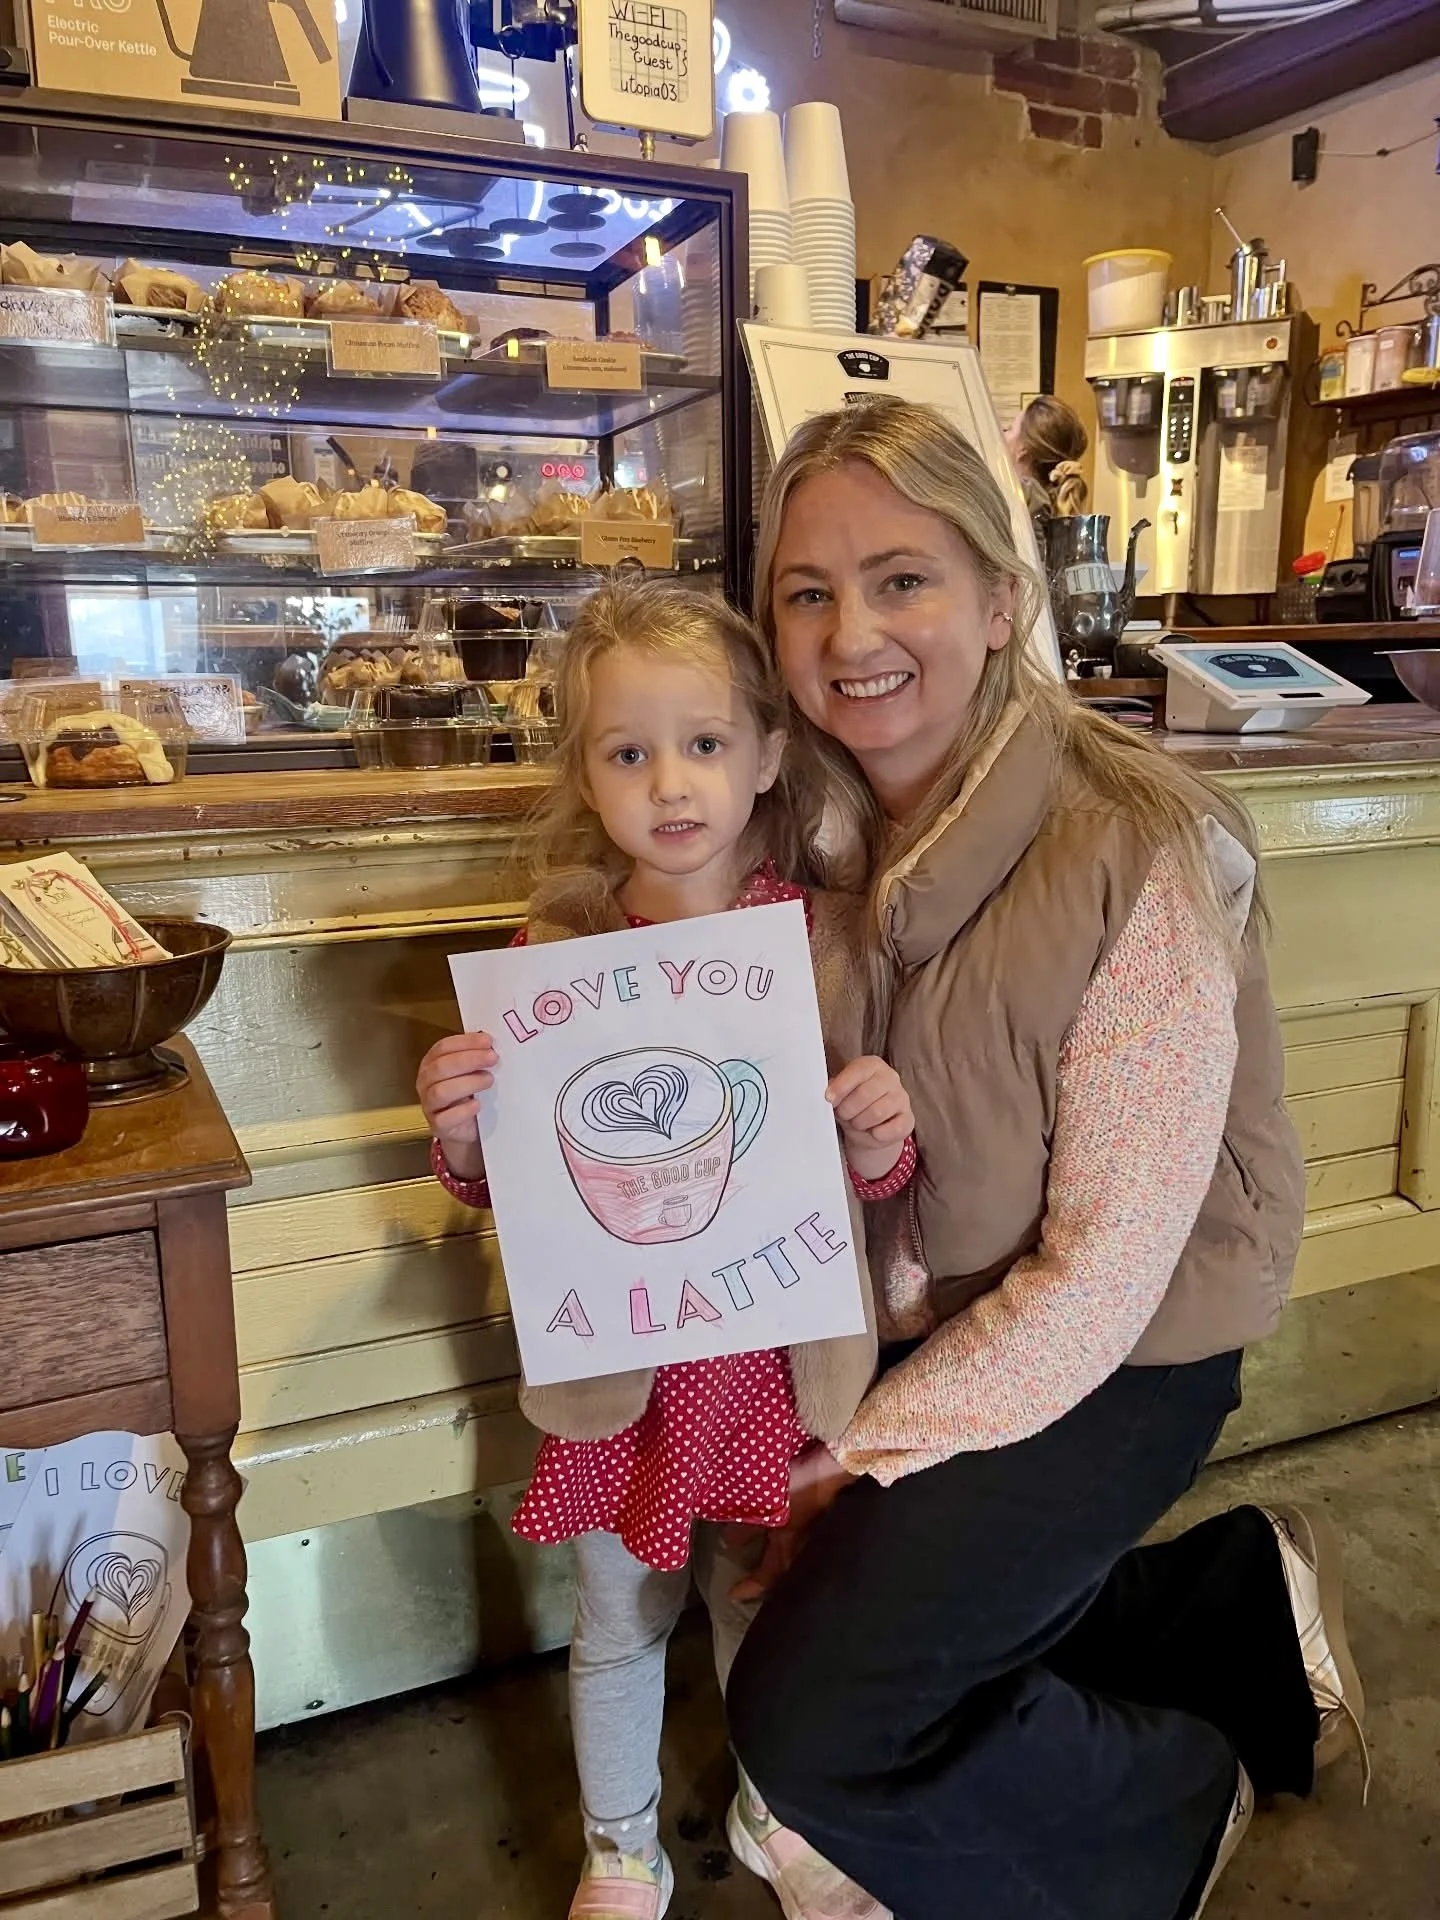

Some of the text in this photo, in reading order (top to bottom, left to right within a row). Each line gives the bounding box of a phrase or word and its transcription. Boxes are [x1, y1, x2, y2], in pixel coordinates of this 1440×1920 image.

[47, 15, 99, 33] Electric
[49, 31, 157, 56] Pour-Over Kettle
[608, 23, 681, 57] Thegoodcup
[633, 51, 673, 70] Guest
[620, 75, 678, 101] utopia03
[502, 959, 774, 1043] LOVE YOU
[617, 1156, 721, 1200] THE GOOD CUP
[546, 1211, 847, 1337] A LATTE
[45, 1467, 60, 1497] I
